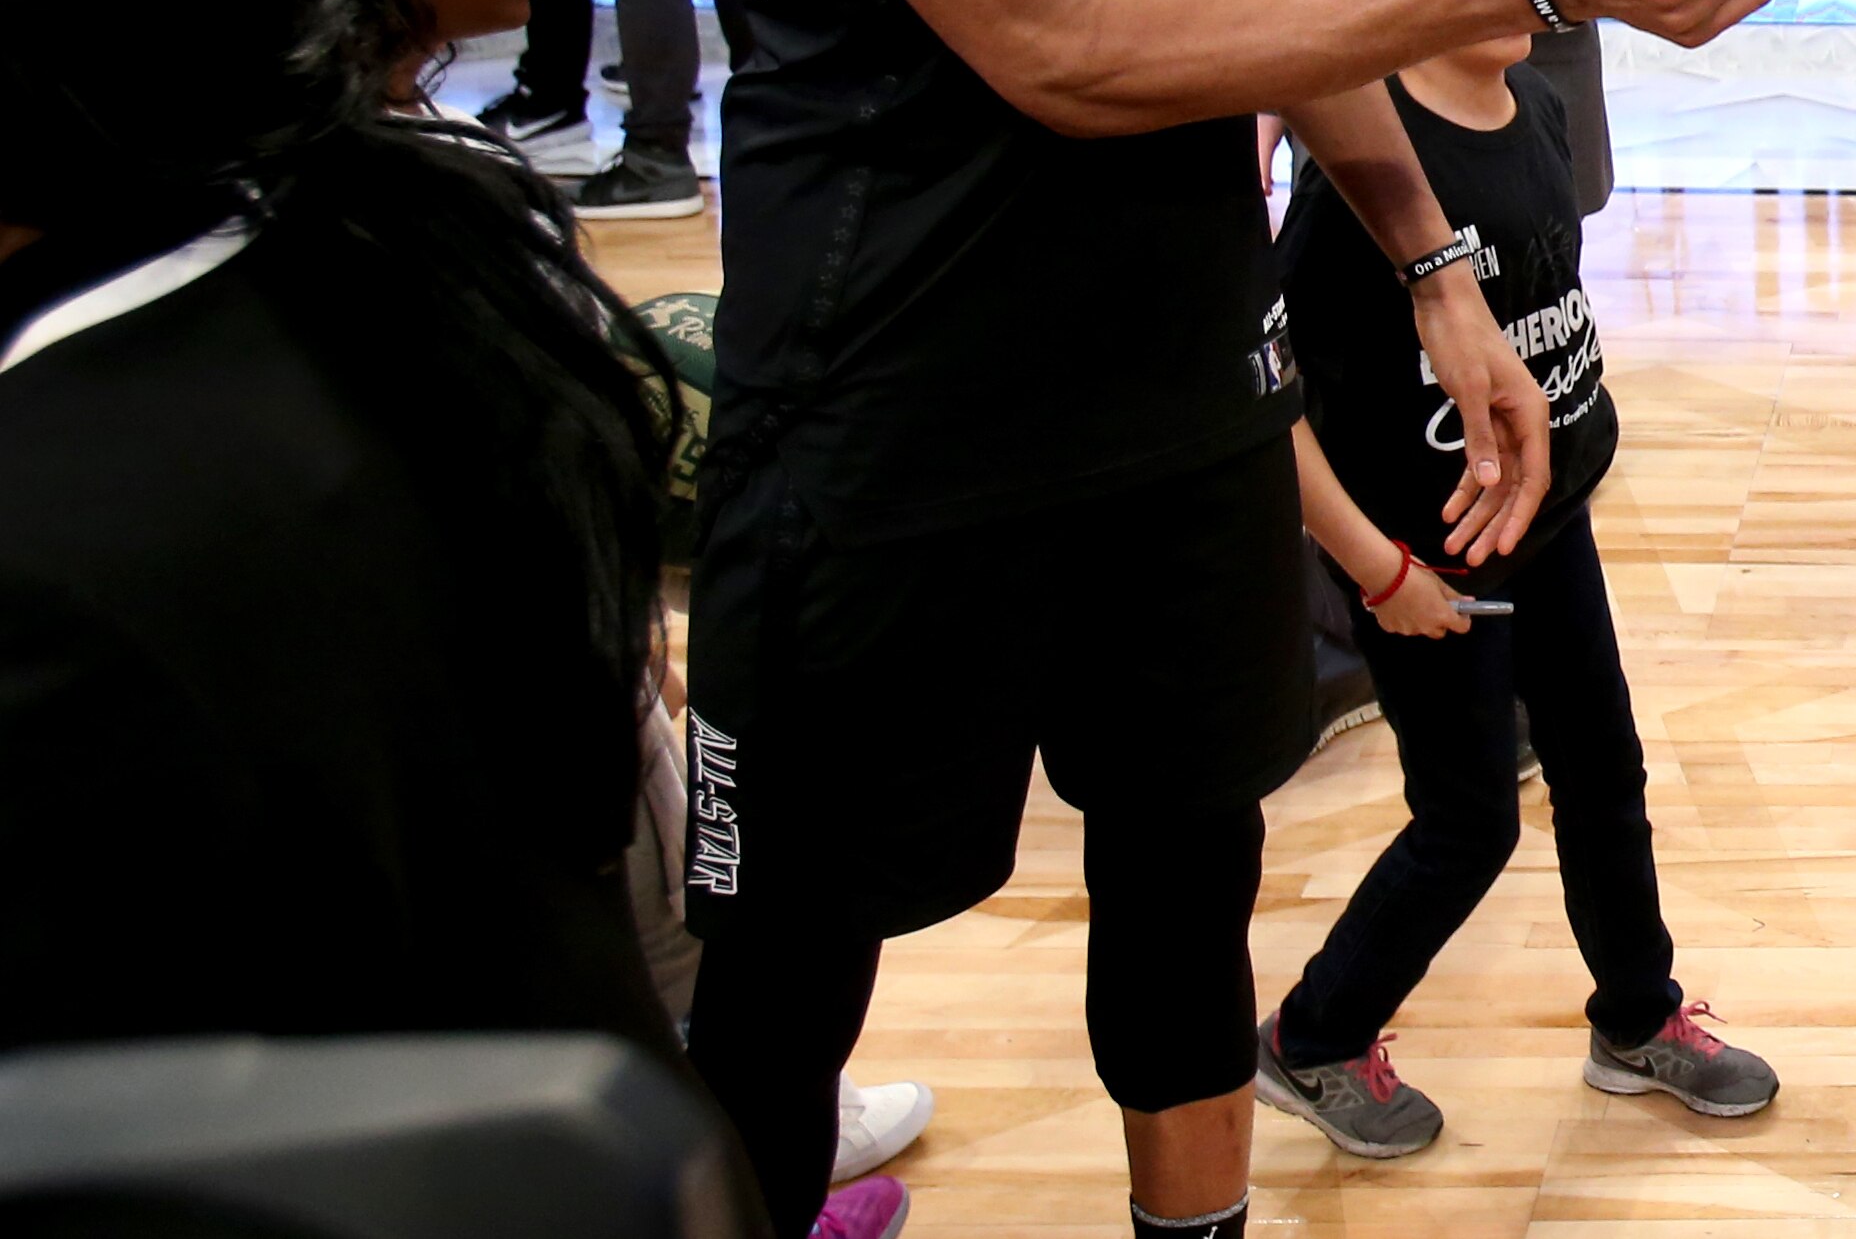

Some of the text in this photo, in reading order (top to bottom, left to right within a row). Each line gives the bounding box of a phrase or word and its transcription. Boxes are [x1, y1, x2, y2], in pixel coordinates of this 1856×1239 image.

[1414, 261, 1434, 276] On
[1434, 256, 1444, 267] a
[688, 706, 741, 894] ALL-STAR
